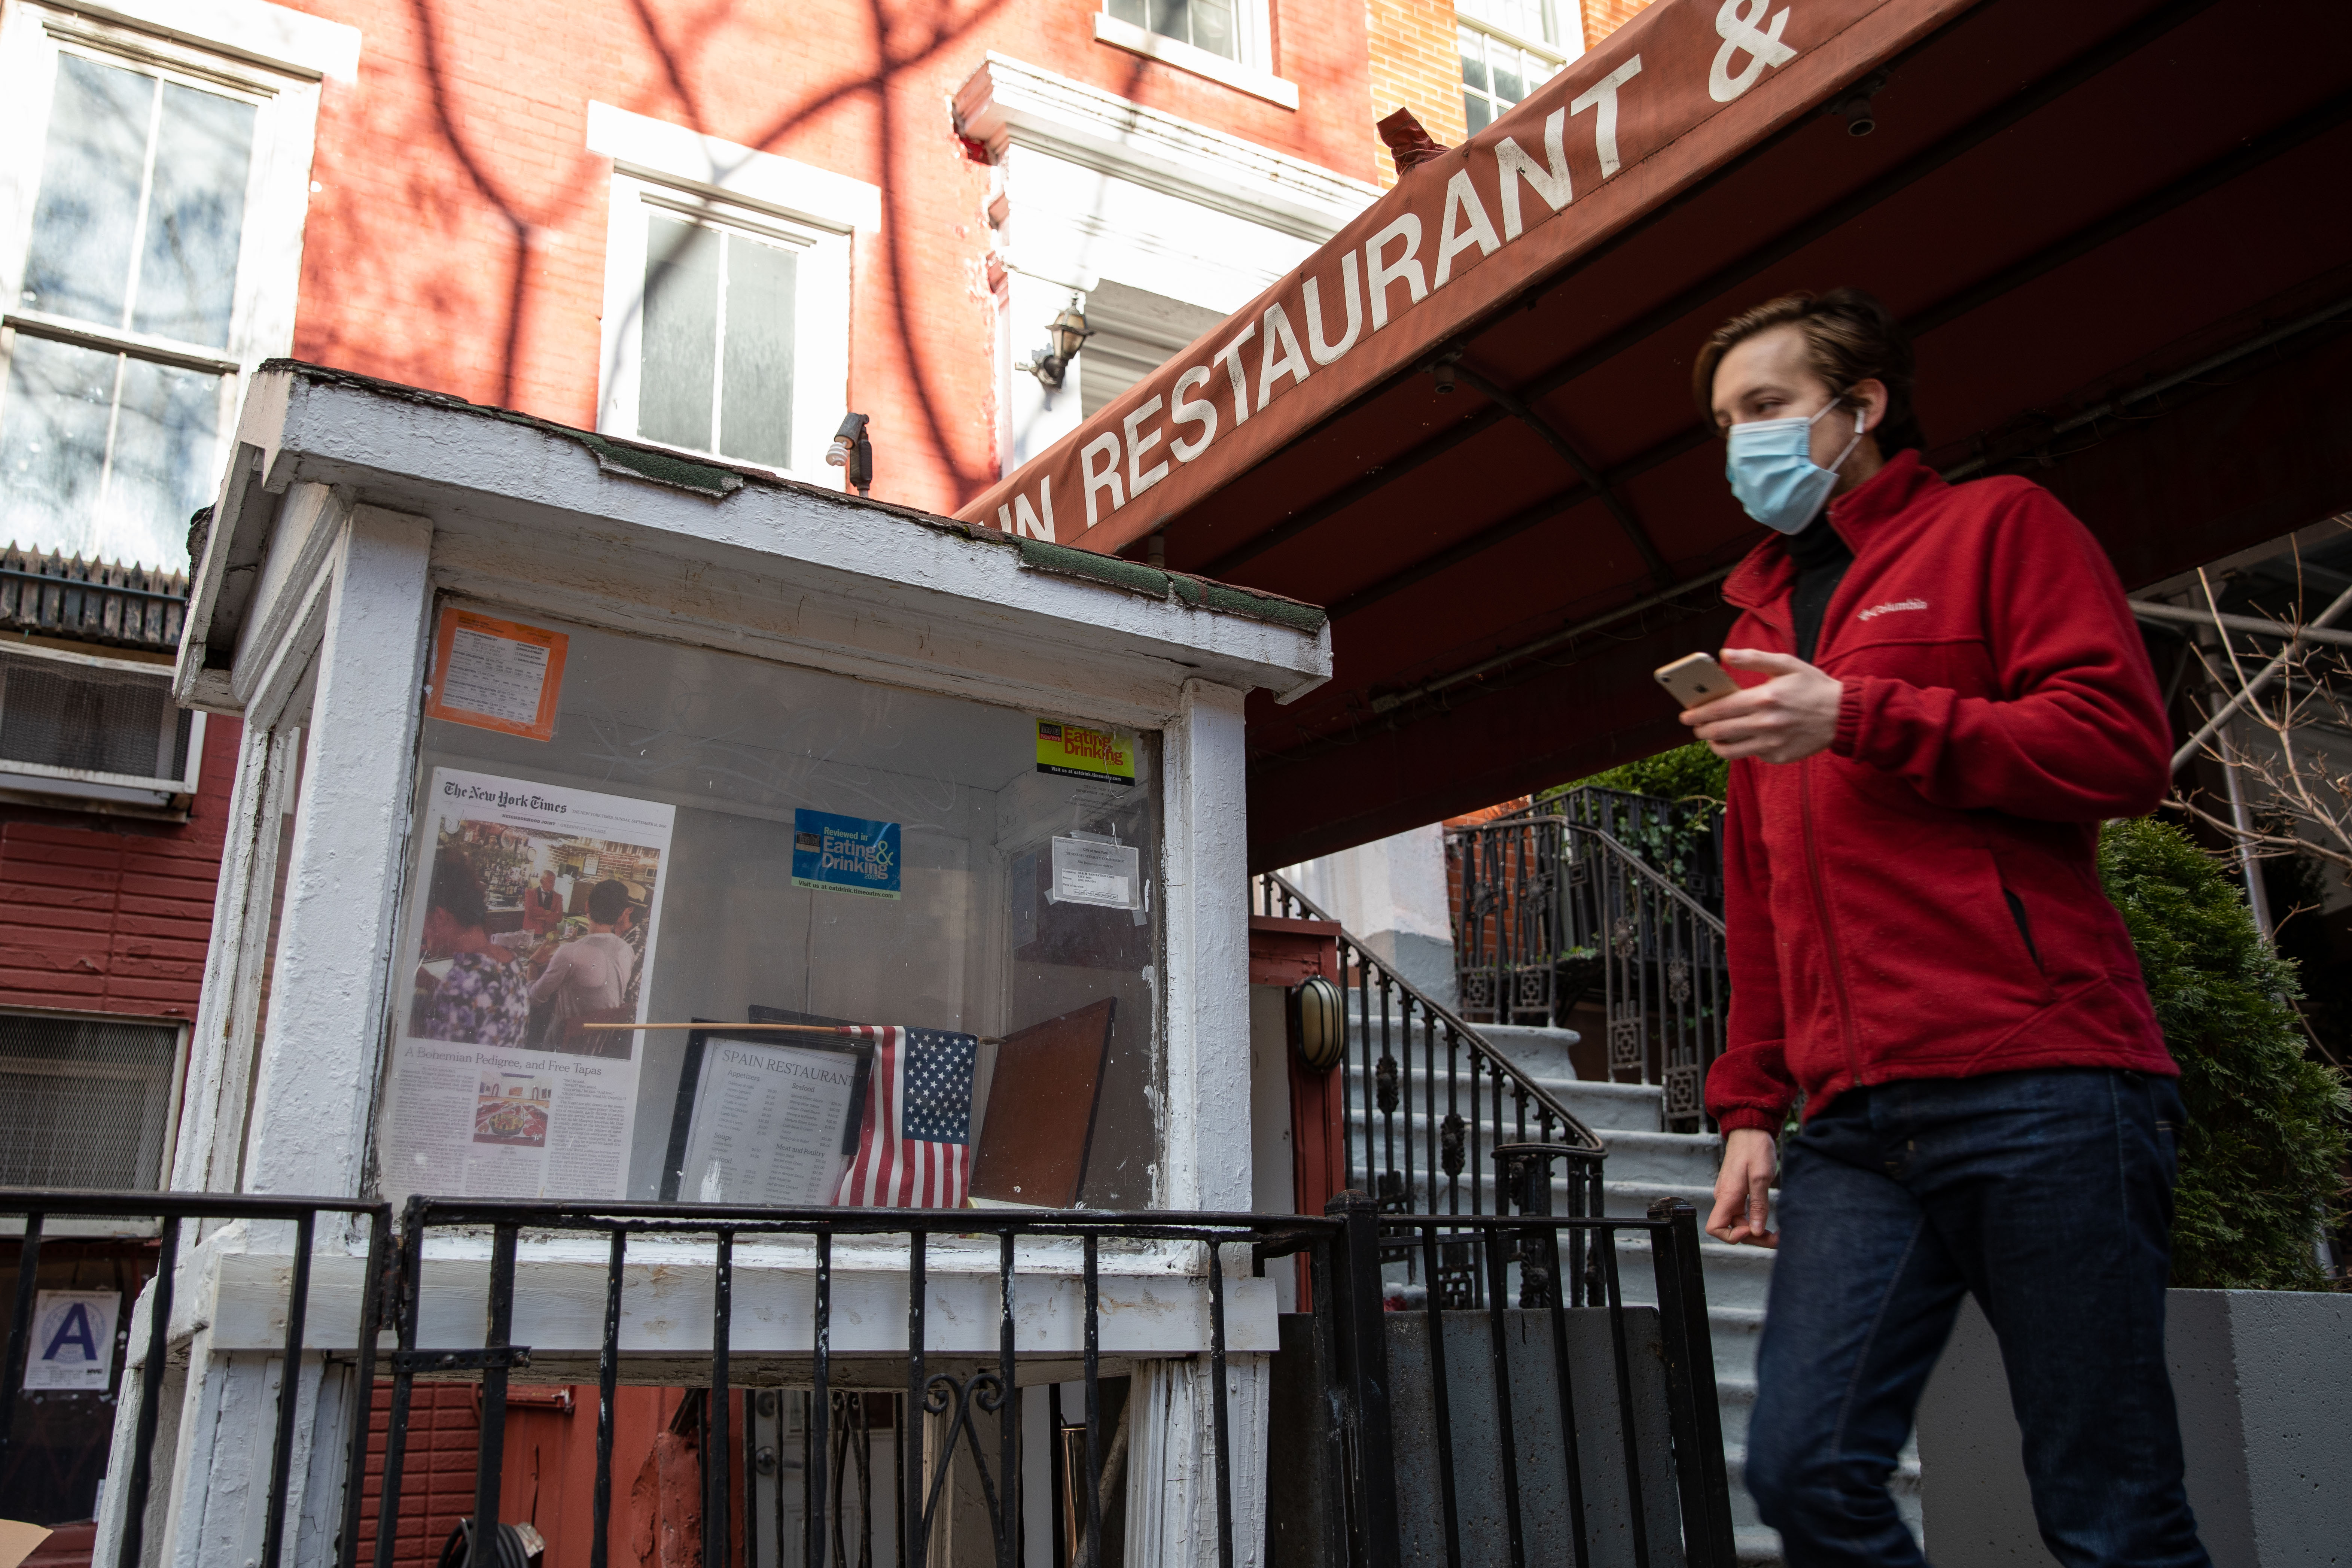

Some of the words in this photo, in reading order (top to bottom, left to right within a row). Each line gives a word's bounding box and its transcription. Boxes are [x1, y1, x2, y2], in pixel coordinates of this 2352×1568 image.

[1080, 54, 1642, 529] RESTAURANT
[1708, 0, 1797, 103] &
[1040, 723, 1051, 734] Time
[1051, 726, 1061, 735] Out
[1064, 726, 1112, 750] Eating
[1064, 740, 1123, 765] Drinking
[1074, 770, 1121, 782] eatdrink.timeoutny.com
[444, 782, 467, 798] The
[469, 786, 496, 801] New
[498, 791, 528, 808] York
[530, 795, 567, 813] Times
[502, 814, 540, 823] NEIGHBORHOOD
[824, 826, 858, 840] Reviewed
[861, 833, 868, 841] in
[823, 835, 877, 862] Eating
[876, 840, 893, 866] &
[822, 852, 889, 879] Drinking
[829, 886, 893, 898] eatdrink.timeoutny.com
[405, 1046, 413, 1057] A
[417, 1047, 472, 1062] Bohemian
[476, 1053, 521, 1069] Pedigree,
[525, 1060, 545, 1070] and
[548, 1060, 570, 1072] Free
[573, 1062, 602, 1076] Tapas
[722, 1050, 764, 1068] SPAIN
[766, 1059, 854, 1087] RESTAURANT
[728, 1070, 760, 1081] Appetizers
[792, 1083, 815, 1093] Seafood
[714, 1132, 732, 1141] Soups
[709, 1154, 732, 1164] Seafood
[804, 1148, 825, 1158] Poultry
[42, 1303, 97, 1360] A
